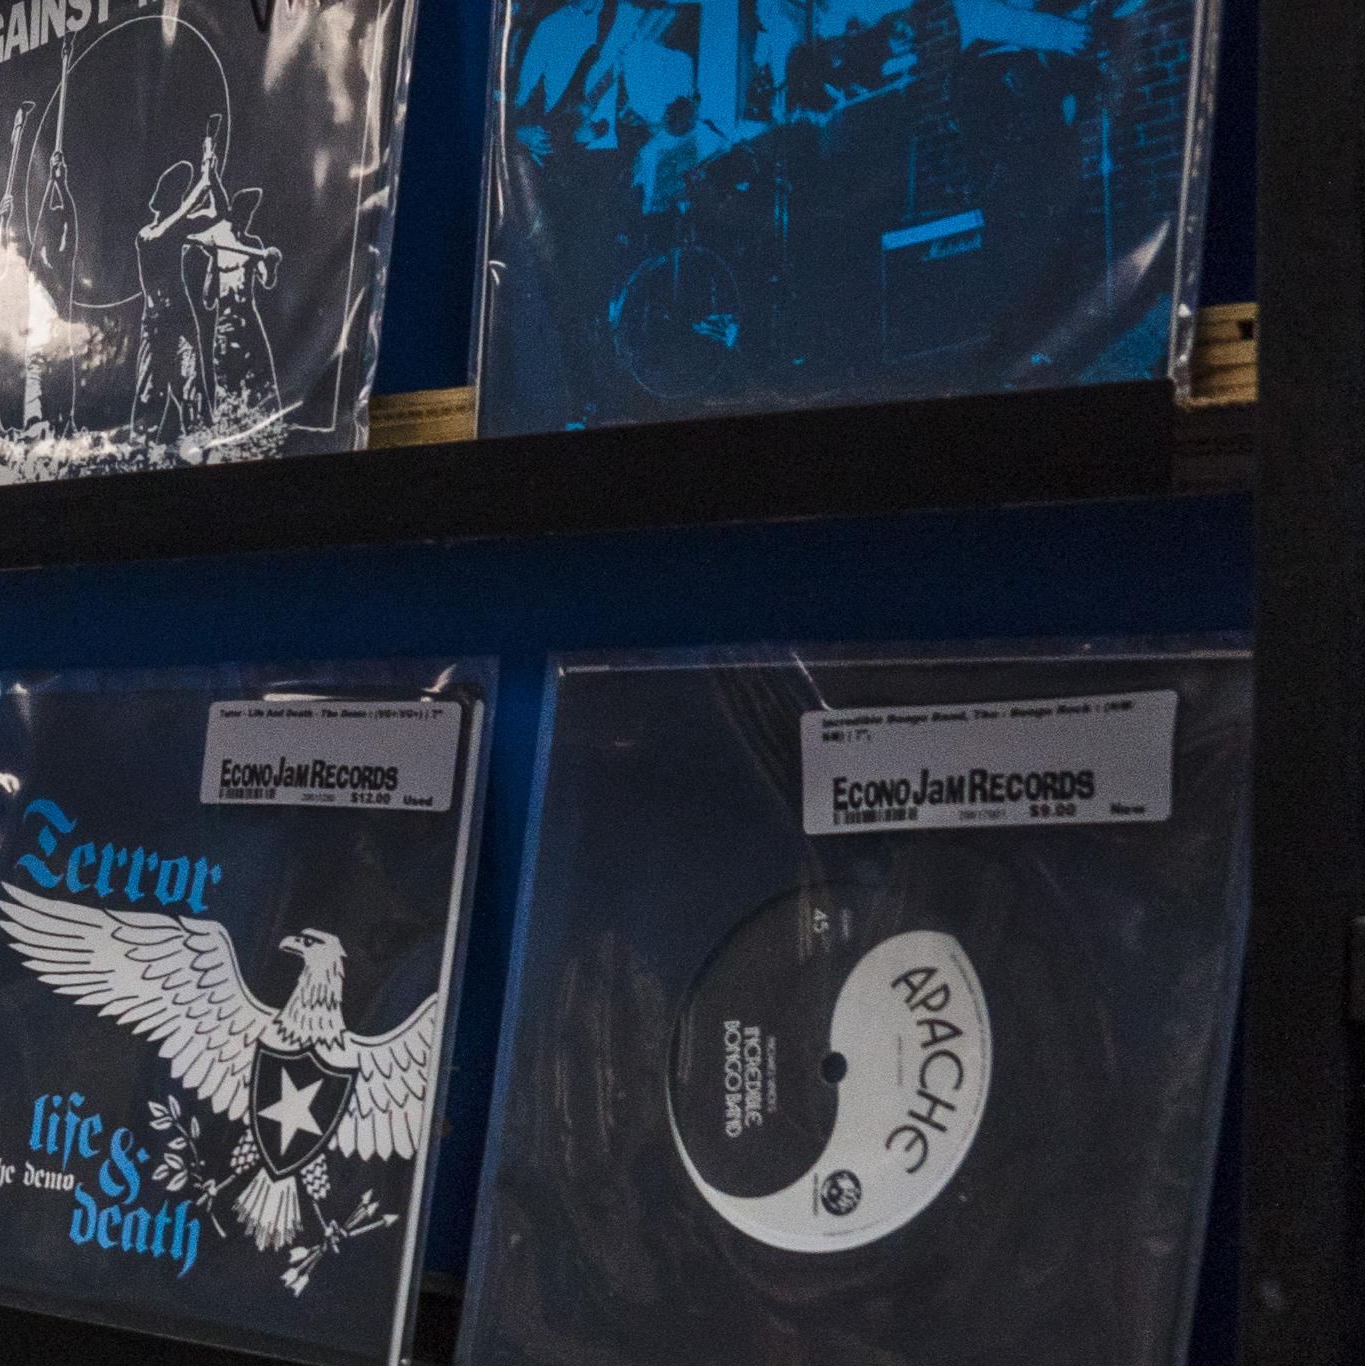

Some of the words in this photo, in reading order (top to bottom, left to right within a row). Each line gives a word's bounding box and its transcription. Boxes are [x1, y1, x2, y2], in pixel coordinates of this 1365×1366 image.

[351, 792, 391, 804] $12.00
[403, 794, 433, 807] Used
[1110, 803, 1147, 816] New
[16, 799, 222, 913] Terror
[723, 1020, 743, 1091] BONGO
[743, 1025, 763, 1128] INCREDIBLE
[885, 964, 965, 1175] APACHE
[29, 1091, 103, 1172] life
[98, 1126, 150, 1204] &
[22, 1163, 75, 1192] demo
[68, 1182, 200, 1280] death
